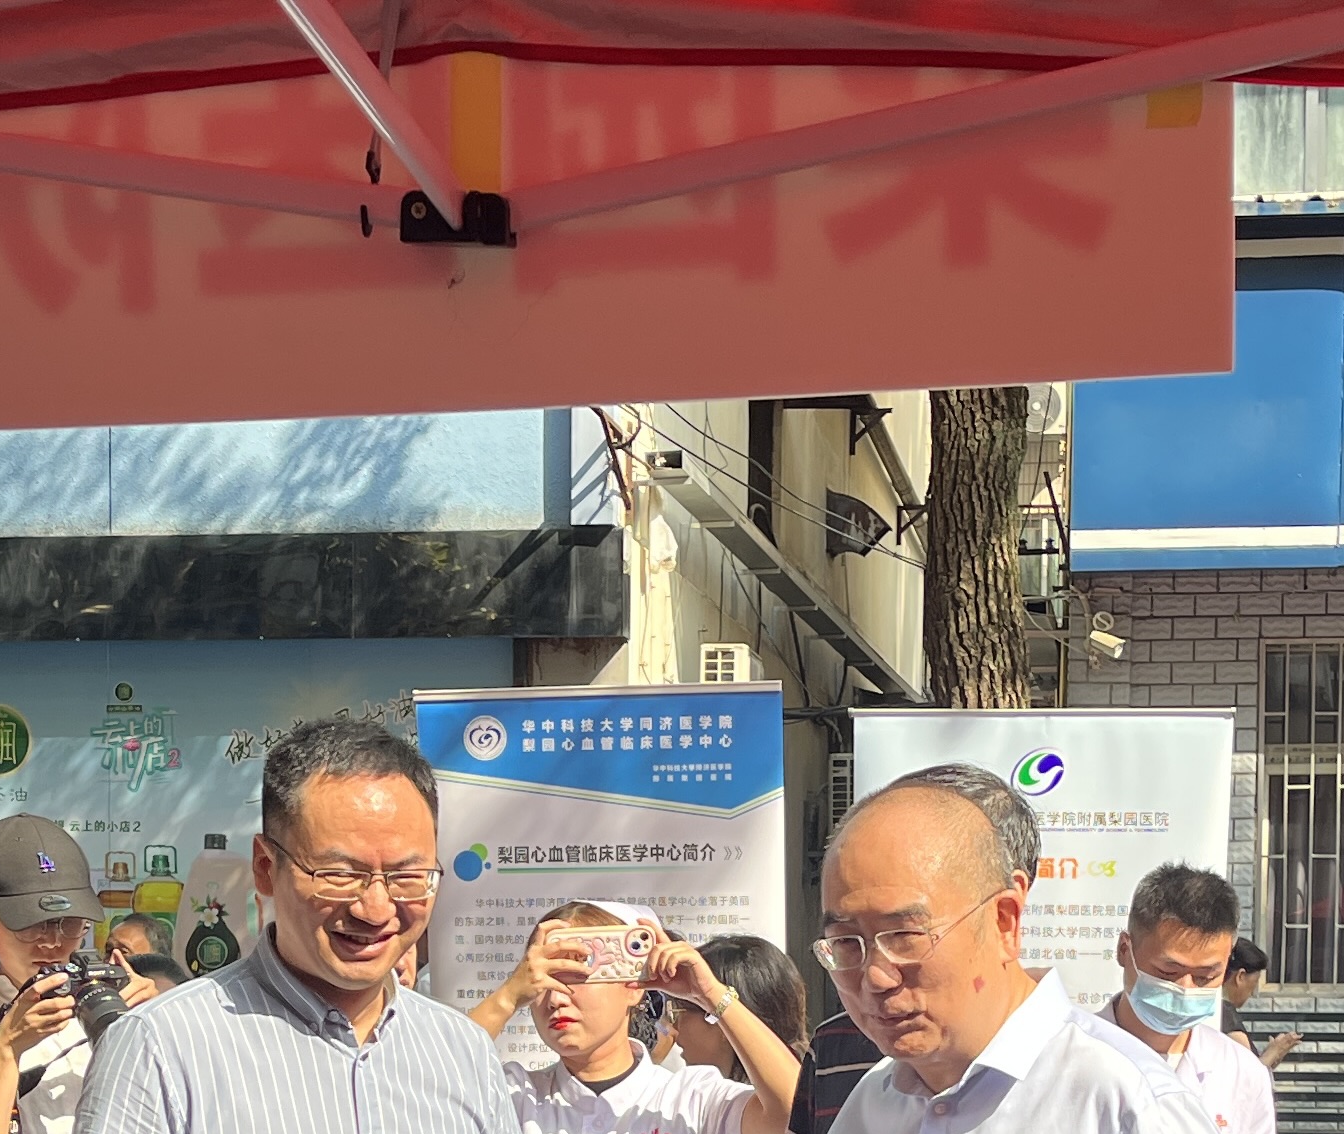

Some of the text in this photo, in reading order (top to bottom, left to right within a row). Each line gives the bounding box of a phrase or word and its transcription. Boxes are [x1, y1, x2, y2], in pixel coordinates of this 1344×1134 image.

[522, 715, 733, 733] 华中科技大学同济医学院
[522, 733, 733, 753] 梨园心血管临床医学中心
[69, 820, 141, 832] 云上的小店2
[497, 843, 716, 864] 梨园心血管临床医学中心简介
